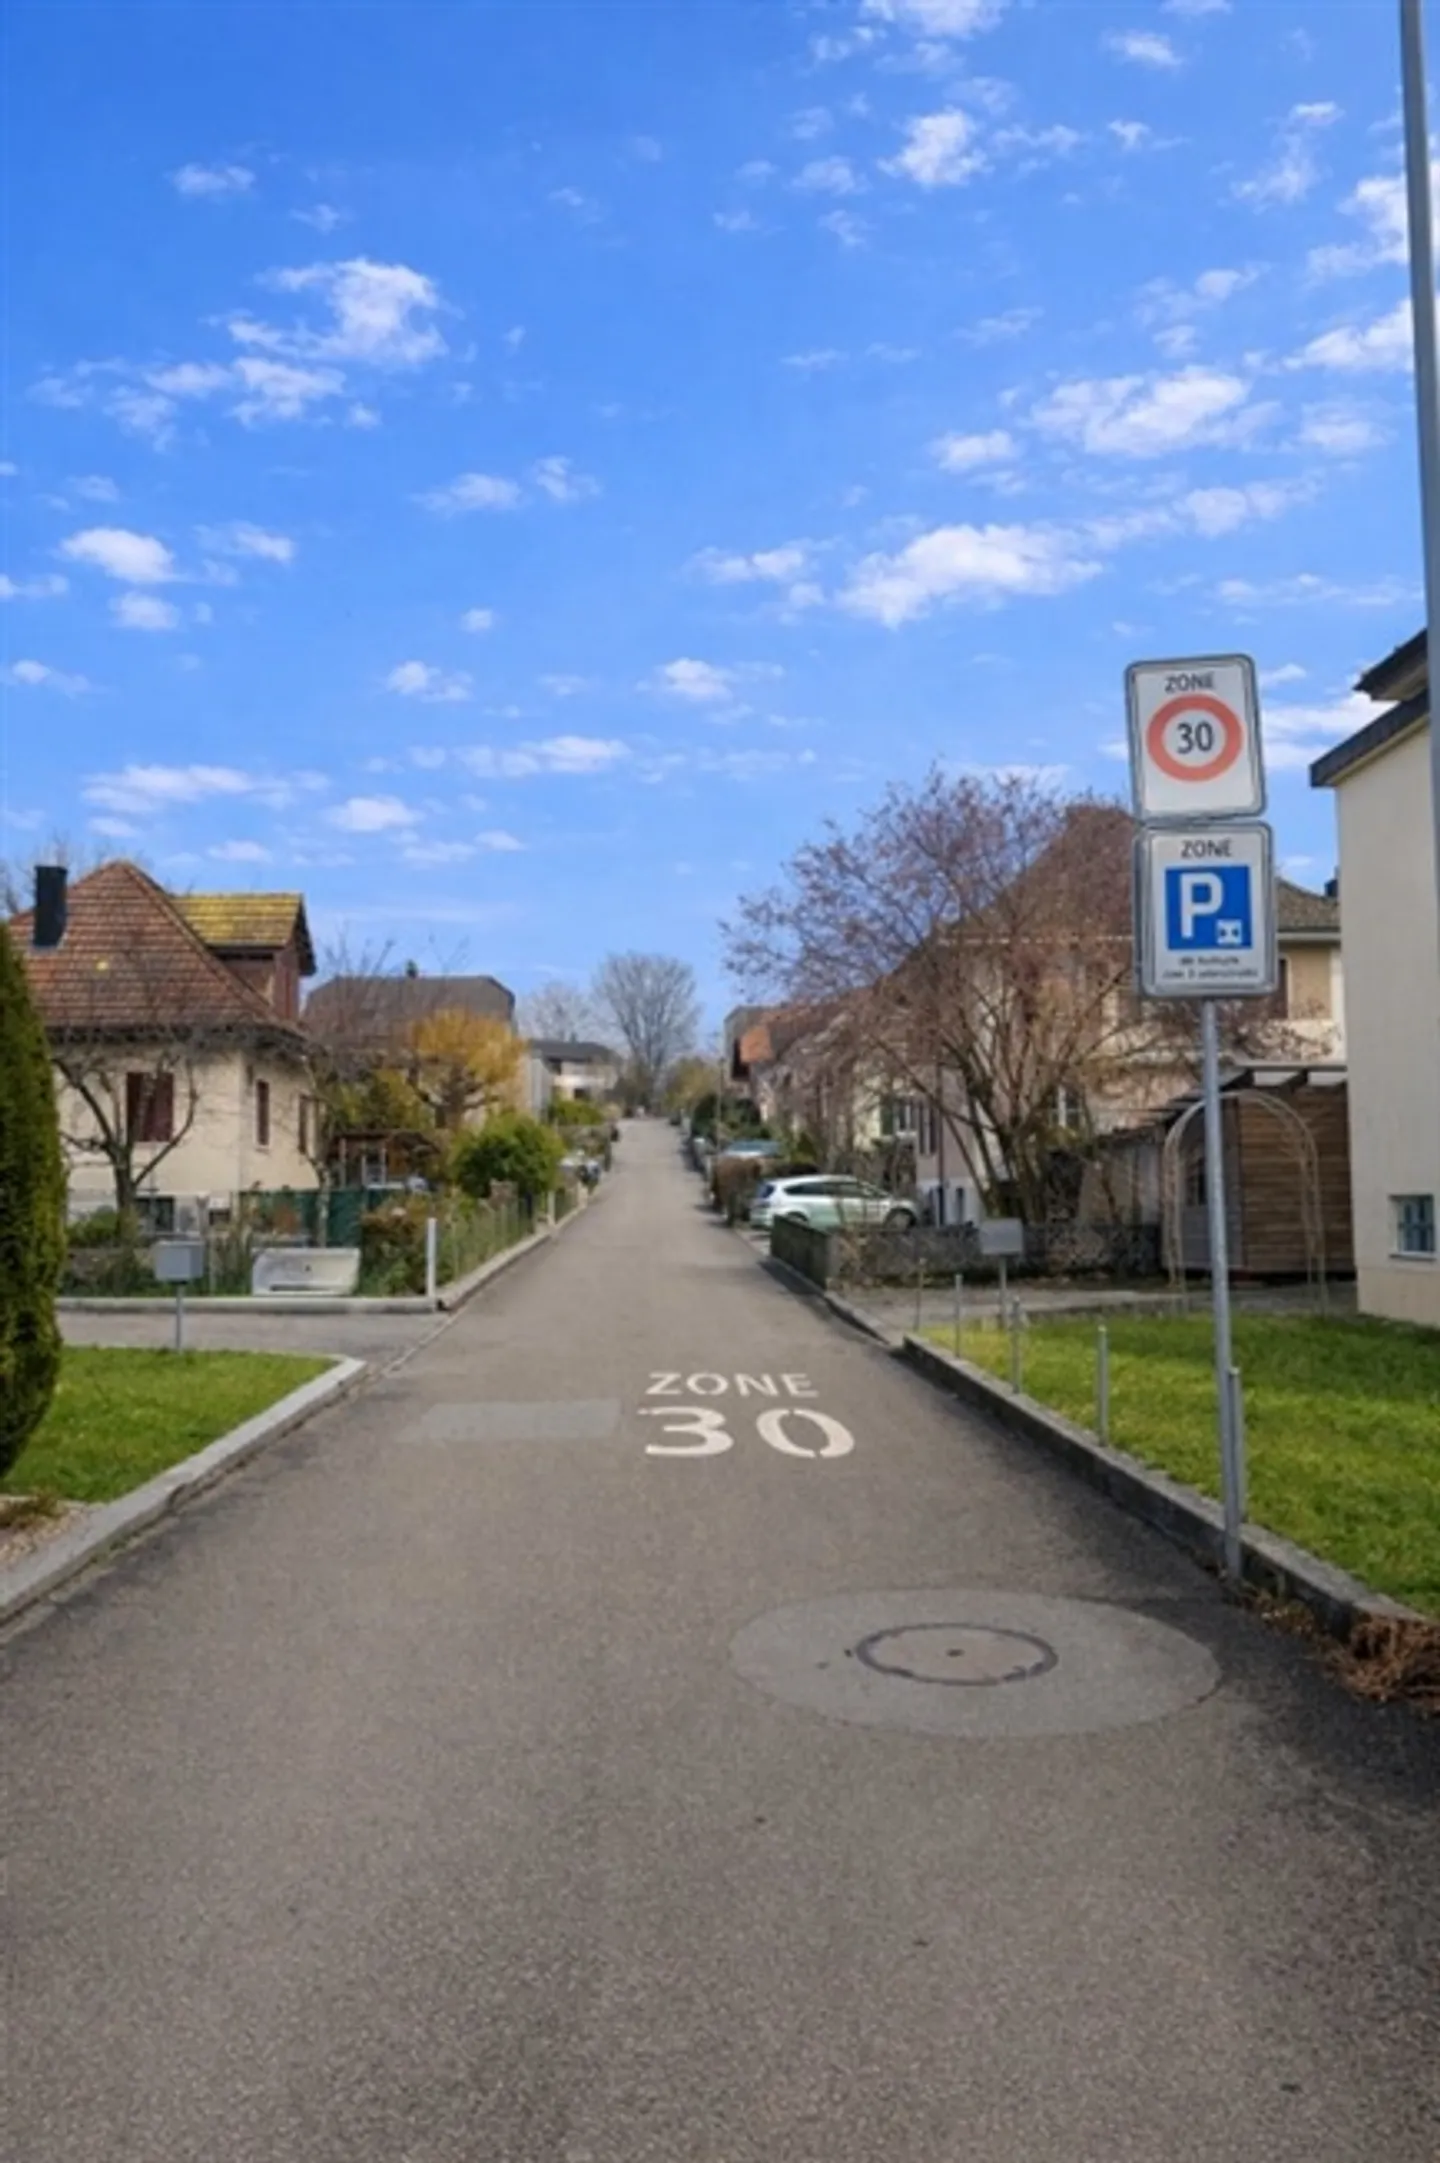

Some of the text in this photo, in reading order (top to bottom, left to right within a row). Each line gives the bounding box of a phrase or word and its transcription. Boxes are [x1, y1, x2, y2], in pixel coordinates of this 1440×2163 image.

[1165, 672, 1214, 692] ZONE
[1177, 721, 1213, 754] 30
[1181, 839, 1231, 858] ZONE
[1180, 872, 1223, 939] P
[645, 1371, 819, 1397] ZONE
[637, 1405, 855, 1458] 30
